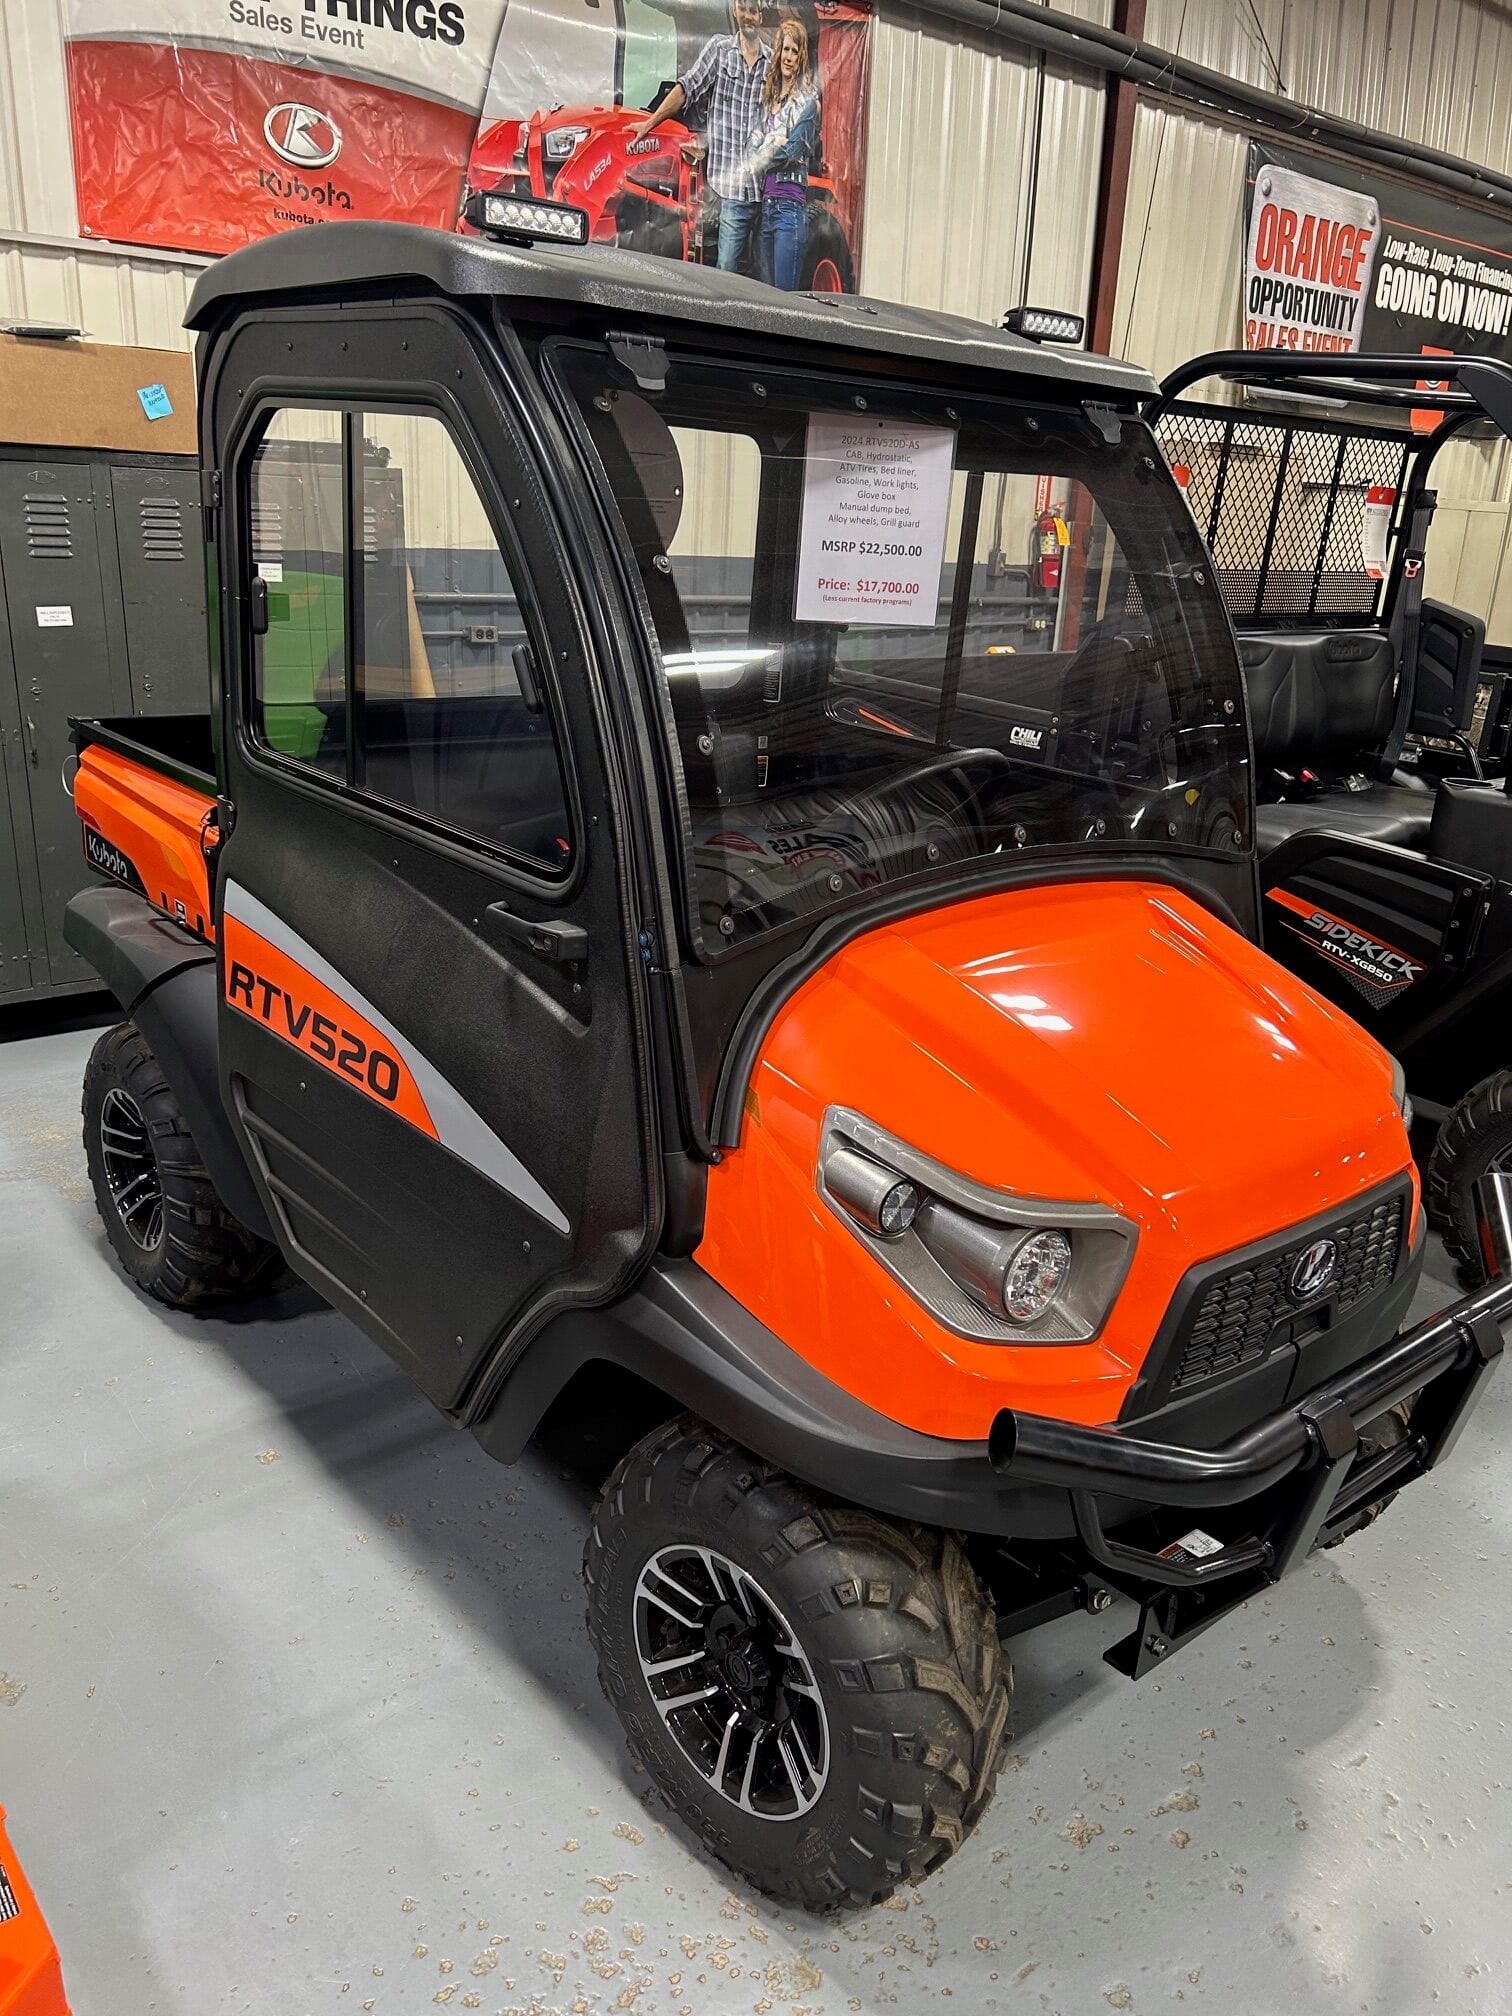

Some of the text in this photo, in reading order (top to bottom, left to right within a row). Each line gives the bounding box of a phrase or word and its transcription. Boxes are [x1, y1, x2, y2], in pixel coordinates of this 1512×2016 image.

[229, 0, 365, 49] Sales Event
[304, 0, 466, 46] INGS
[258, 169, 352, 210] Kubota
[1255, 202, 1373, 292] ORANGE
[1383, 235, 1430, 270] Low-Rate,
[1429, 248, 1478, 280] Long-Term
[1249, 275, 1360, 333] OPPORTUNITY
[1375, 262, 1512, 336] GOING ON NOW!
[841, 435, 863, 446] 2024
[846, 449, 913, 464] CAB, Hydrostatic,
[835, 475, 919, 490] Gasoline, Work lights,
[840, 463, 856, 472] ATV
[857, 464, 879, 474] Tires,
[880, 466, 896, 475] Bed
[839, 502, 869, 512] Manual
[870, 504, 893, 515] dump
[857, 490, 896, 501] Glove box
[828, 514, 921, 529] Alloy wheels, Grill guard
[821, 540, 922, 557] MSRP $22,500.00
[817, 577, 919, 595] Price: $17,700.00
[822, 594, 912, 607] (Less current factory programs)
[88, 834, 128, 879] Kubota
[1303, 912, 1424, 981] SIDEKICK
[1321, 939, 1393, 982] RTV-XG850
[228, 959, 400, 1102] RTV520
